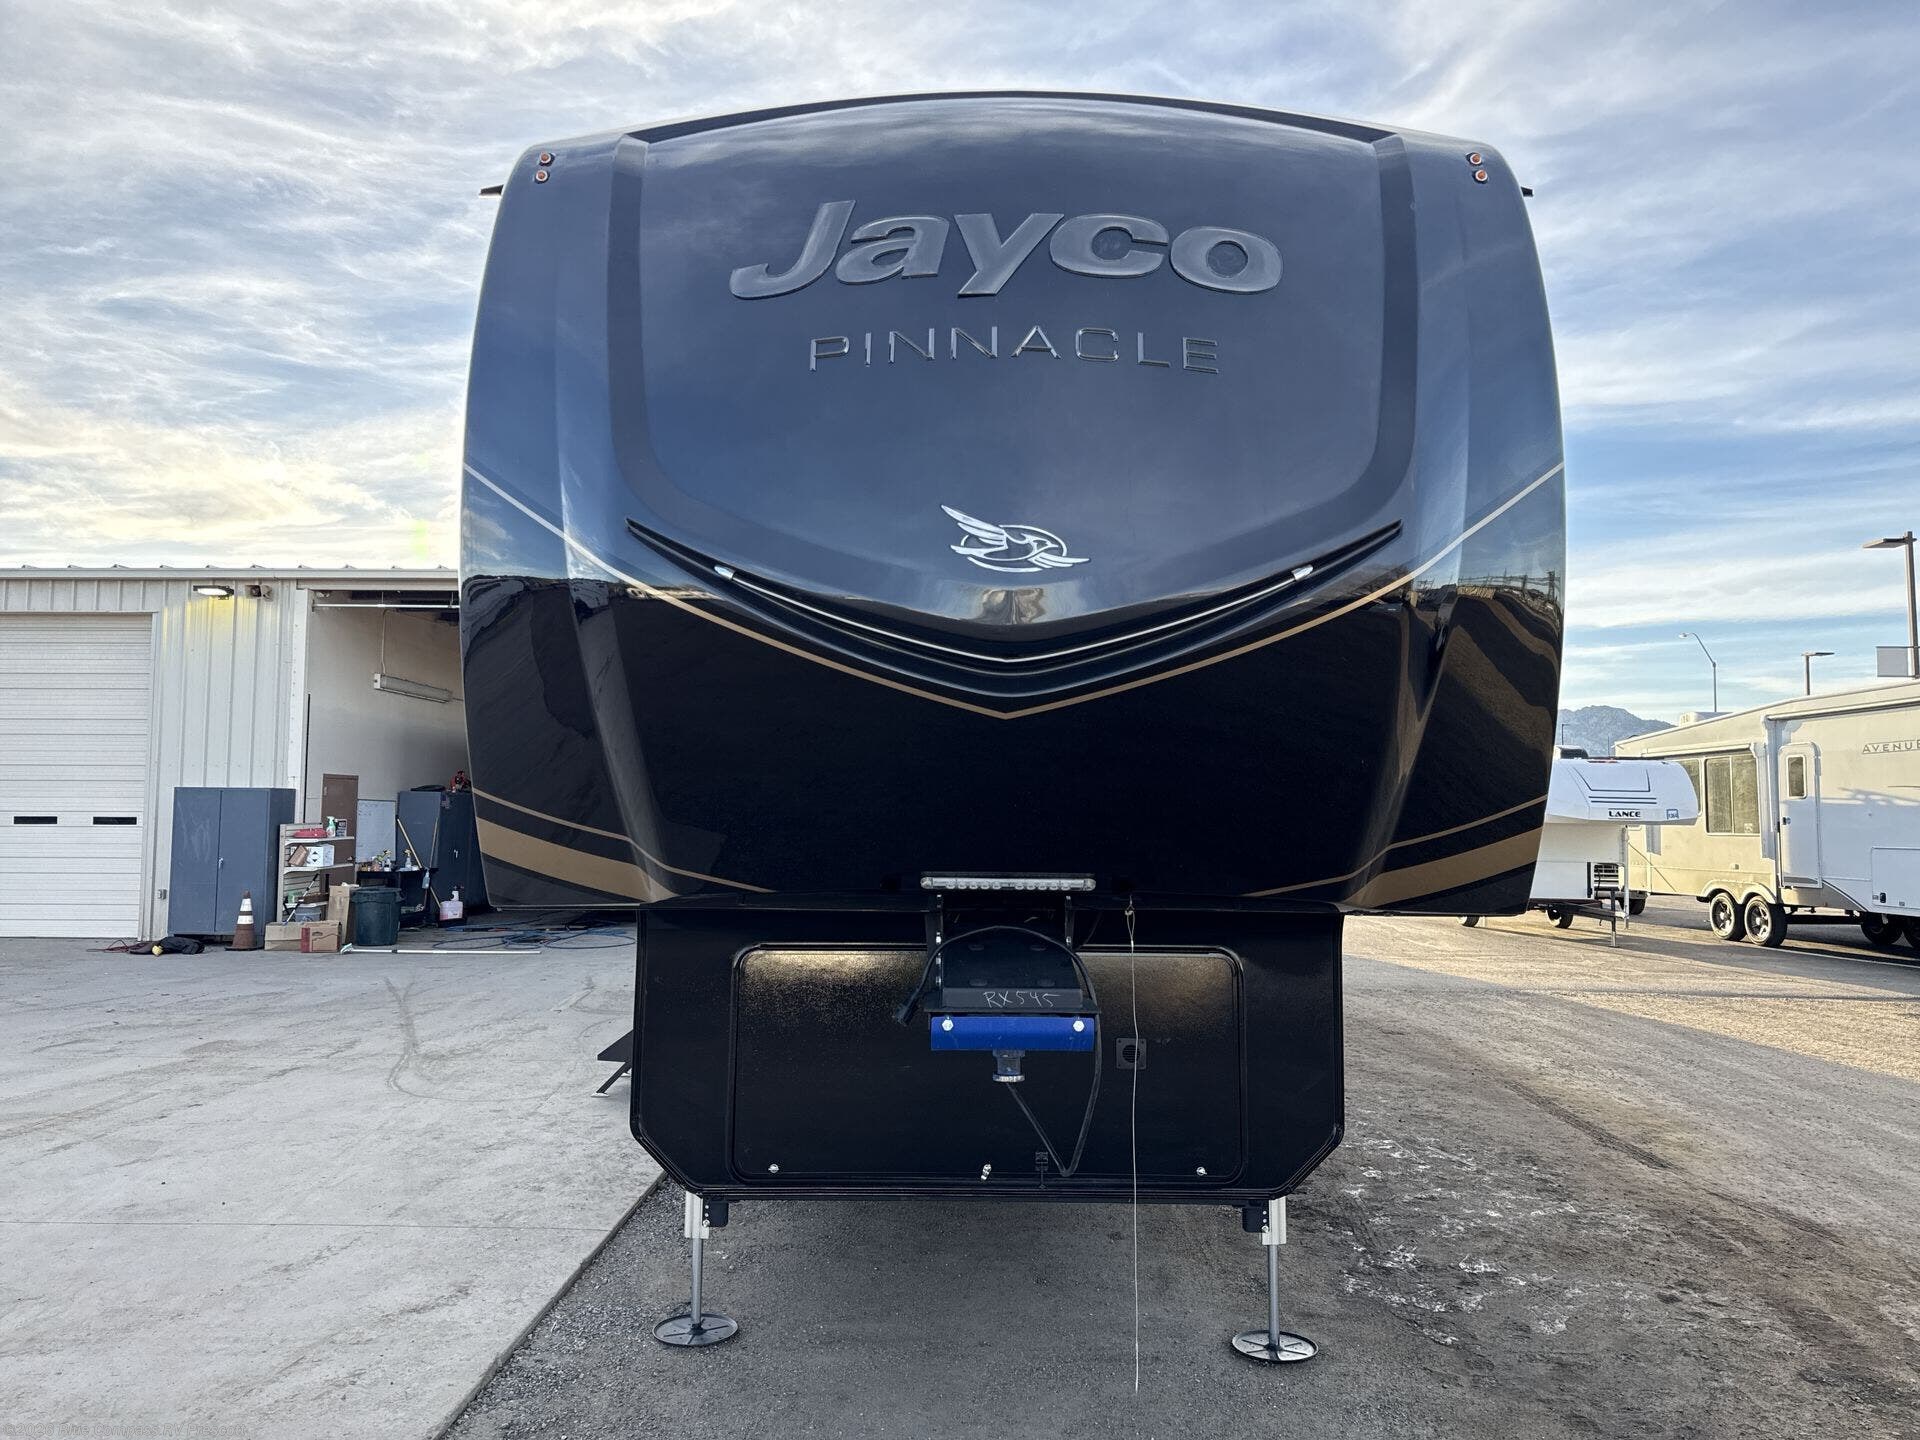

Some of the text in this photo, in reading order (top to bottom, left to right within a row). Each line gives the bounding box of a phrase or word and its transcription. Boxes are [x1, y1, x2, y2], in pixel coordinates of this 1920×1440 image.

[729, 199, 1284, 300] Jayco
[809, 325, 1220, 374] PINNACLE
[1608, 810, 1641, 818] LANCE
